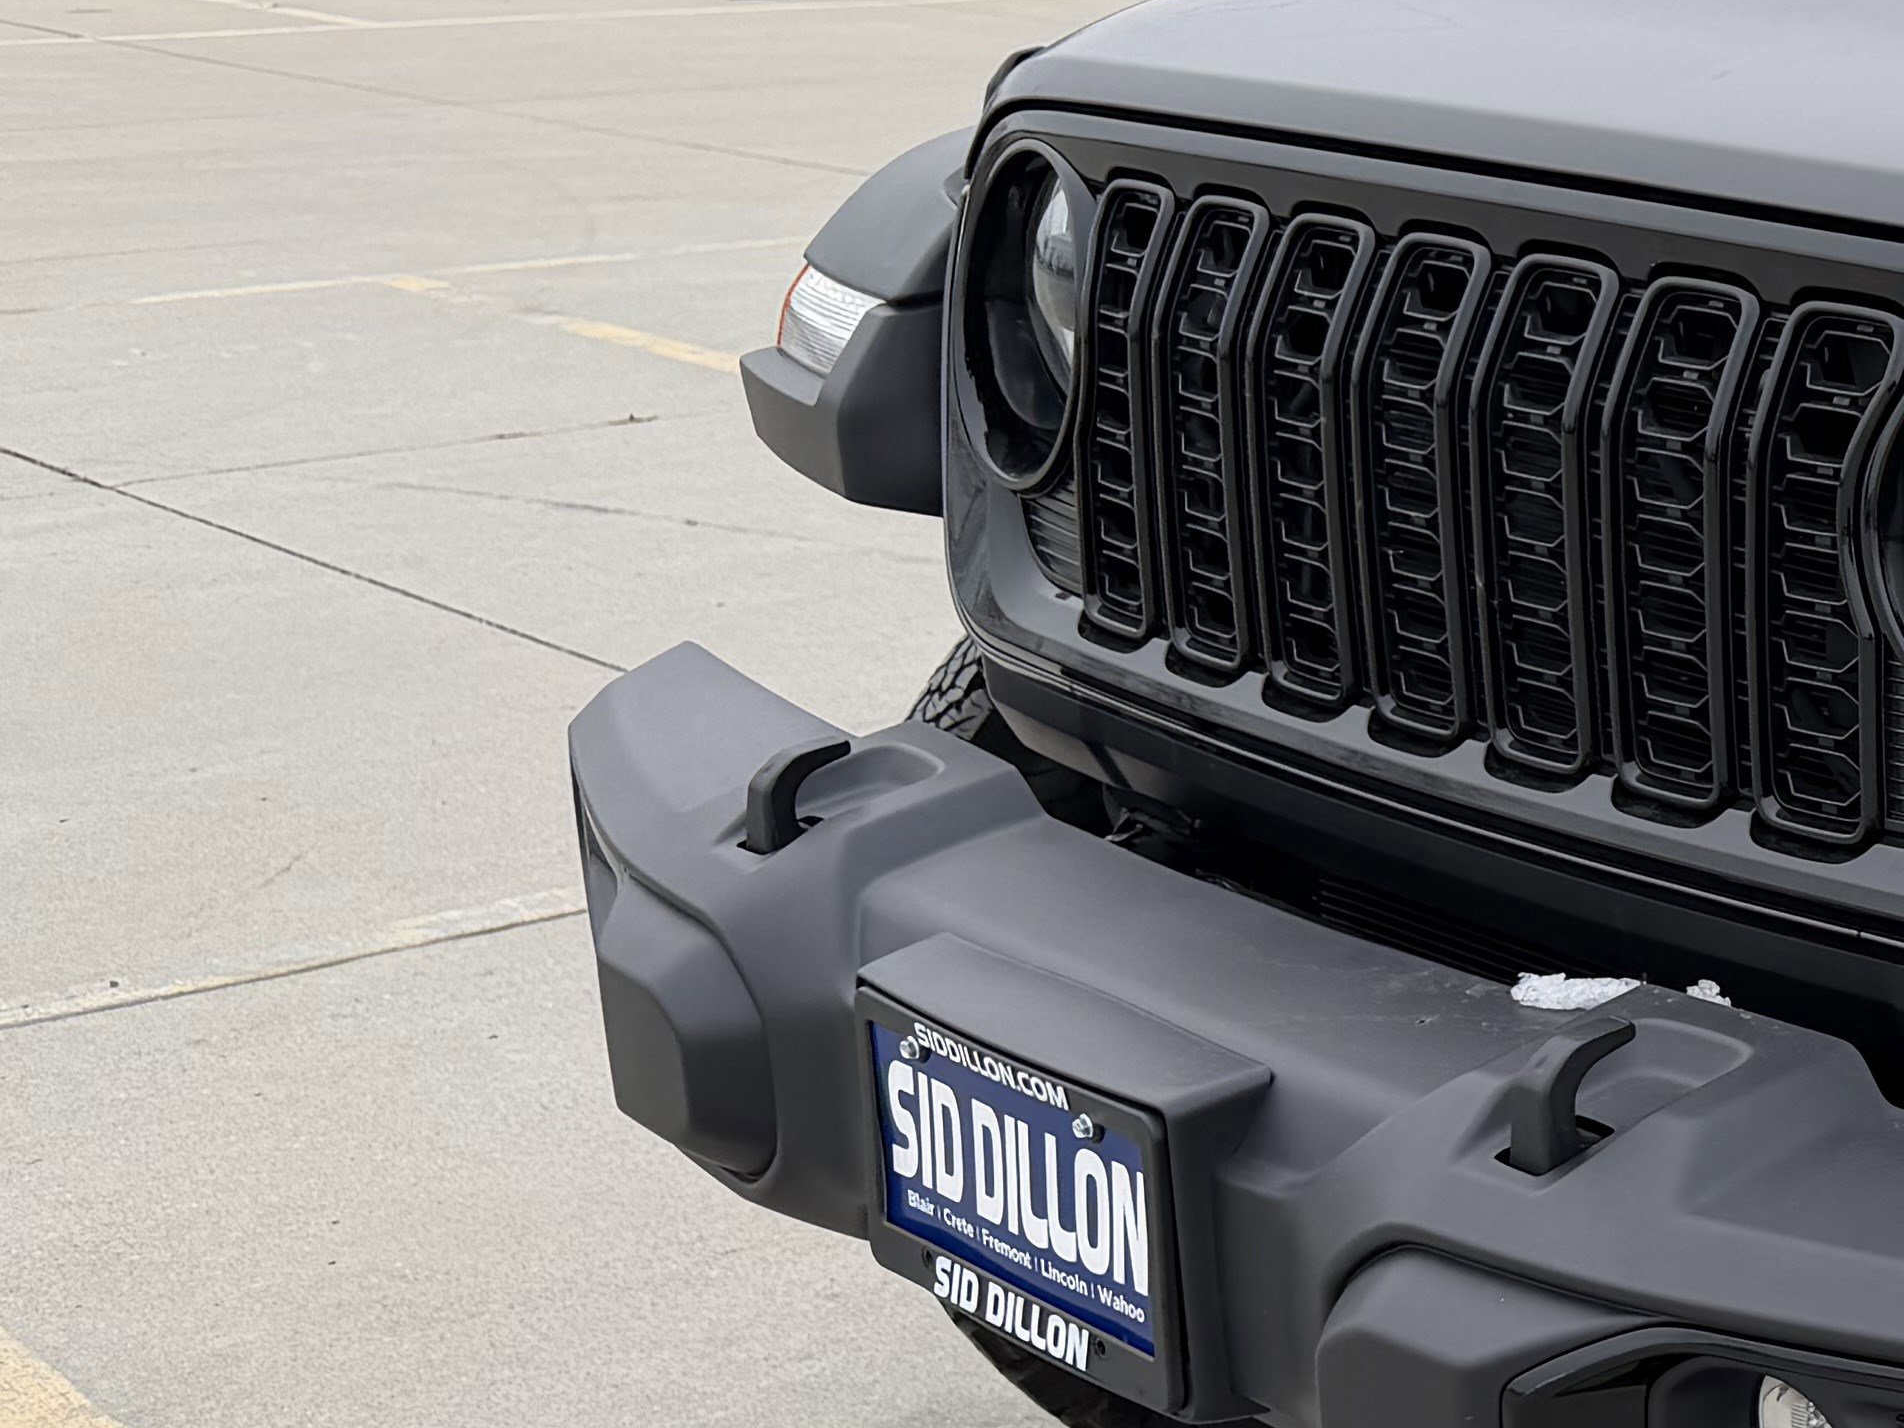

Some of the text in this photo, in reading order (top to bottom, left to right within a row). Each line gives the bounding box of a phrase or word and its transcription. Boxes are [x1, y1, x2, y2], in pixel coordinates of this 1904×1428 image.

[914, 1022, 1070, 1110] SIDDILLON.COM
[888, 1060, 1149, 1296] SID DILLON
[907, 1189, 1146, 1323] Blair Crete Fremont Lincoln Wahoo
[933, 1255, 1090, 1372] SID DILLON
